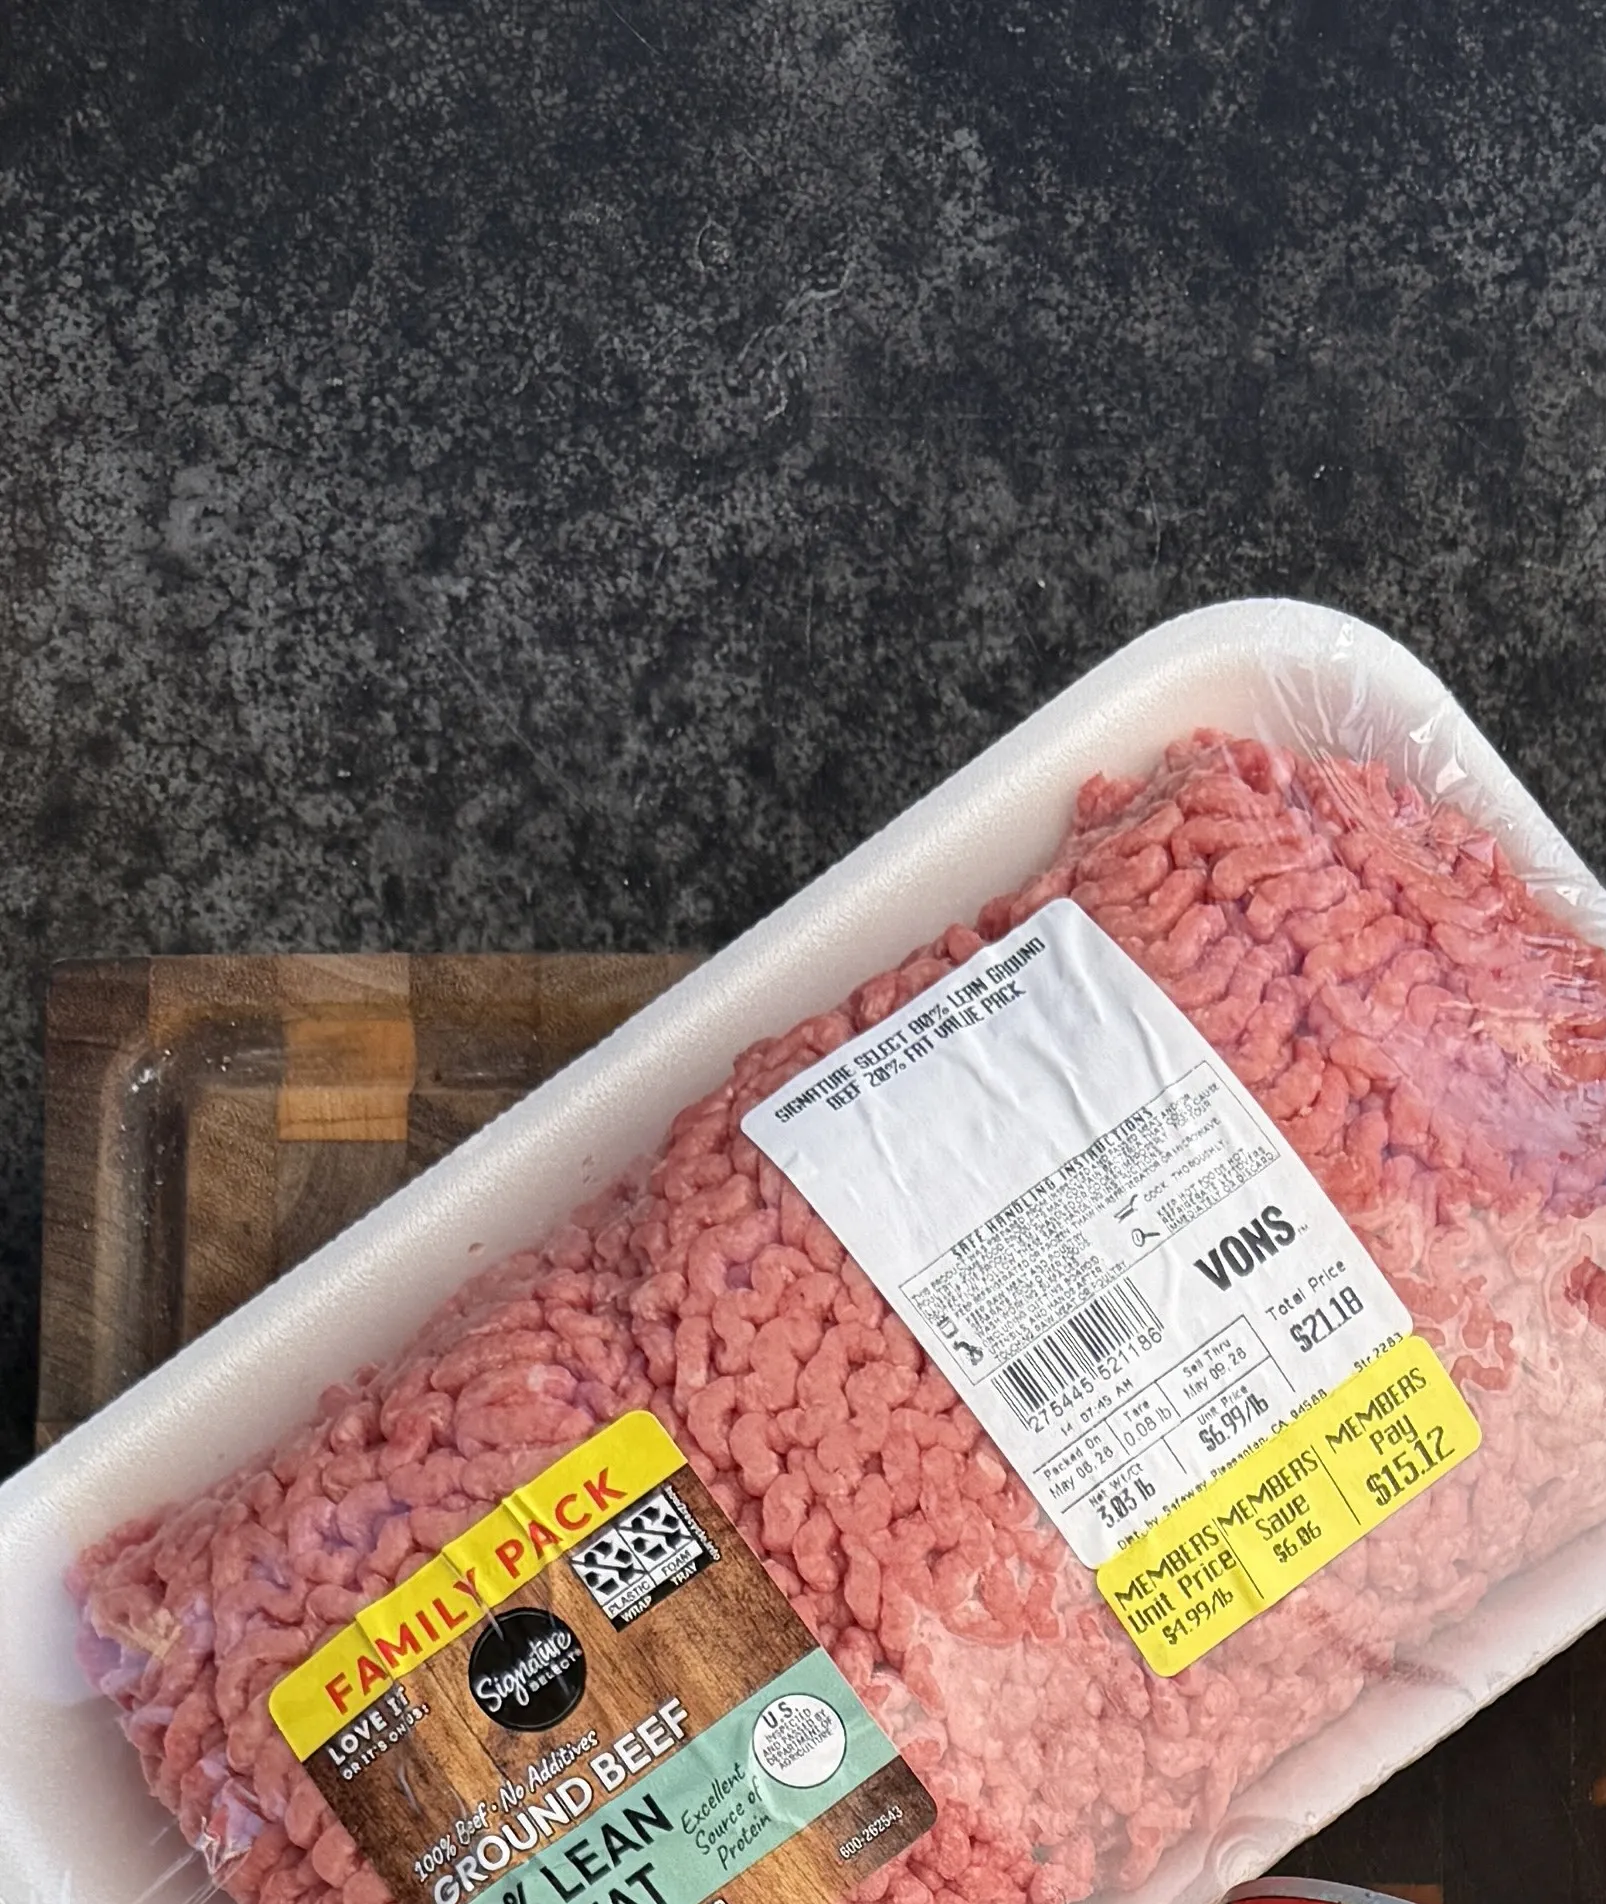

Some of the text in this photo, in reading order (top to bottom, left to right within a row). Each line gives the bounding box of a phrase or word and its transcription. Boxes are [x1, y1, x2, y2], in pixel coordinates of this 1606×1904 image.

[774, 935, 1046, 1125] SIGNATURE SELECT 80% LEAN GROUND
[826, 978, 1026, 1112] BEEF 20% FAT VALUE PACK
[1192, 1201, 1298, 1297] VONS
[1265, 1259, 1347, 1323] Total Price
[1287, 1284, 1366, 1354] $21.18
[1027, 1325, 1163, 1434] 275445 521186
[1198, 1389, 1271, 1453] $6.99/lb
[1323, 1366, 1431, 1454] MEMBERS
[1362, 1424, 1459, 1508] $15.12
[1368, 1411, 1421, 1461] Pay
[1096, 1474, 1157, 1529] 3.03 lb
[1214, 1449, 1321, 1536] MEMBERS
[1252, 1490, 1312, 1542] Save
[1113, 1524, 1221, 1611] MEMBERS
[1271, 1518, 1324, 1565] $6.06
[323, 1464, 628, 1715] FAMILY PACK
[1127, 1545, 1238, 1635] Unit Price
[1160, 1583, 1237, 1647] $4.99/lb
[474, 1628, 575, 1714] Signature
[327, 1685, 411, 1767] LOVE IT
[591, 1697, 697, 1792] BEEF
[410, 1727, 602, 1882] 100% Beef No Additives
[676, 1760, 750, 1836] Excellent
[692, 1780, 764, 1857] Source of
[713, 1807, 776, 1872] Protein
[838, 1804, 905, 1860] 600-262543
